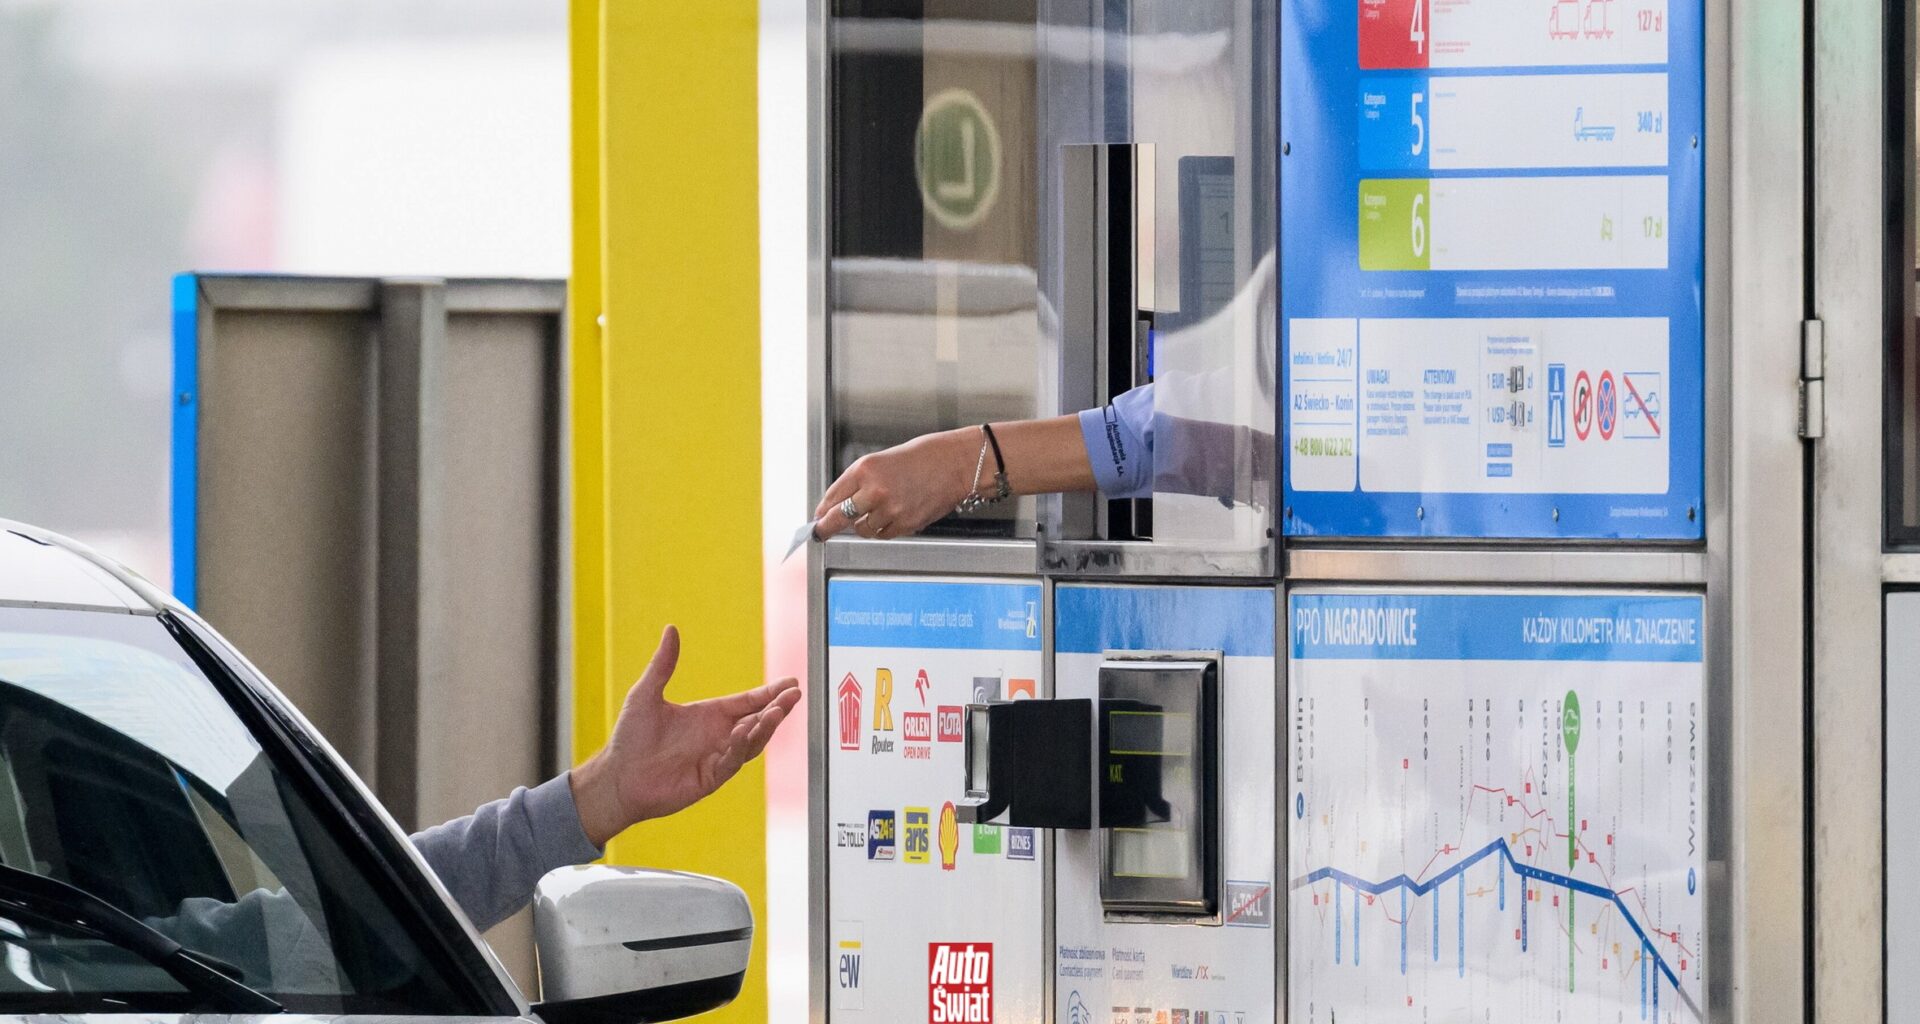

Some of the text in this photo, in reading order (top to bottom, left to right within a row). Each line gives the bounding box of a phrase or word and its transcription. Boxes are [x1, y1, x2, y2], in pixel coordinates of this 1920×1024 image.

[1410, 0, 1425, 54] 4
[1638, 10, 1653, 32] 127
[1411, 93, 1424, 156] 5
[1638, 111, 1653, 133] 340
[1411, 194, 1425, 257] 6
[1643, 216, 1653, 238] 17
[1337, 348, 1352, 368] 24/7
[1367, 369, 1390, 385] UWAGA!
[1423, 369, 1457, 385] ATTENTION!
[1492, 373, 1504, 389] EUR
[1294, 393, 1302, 411] A2
[1304, 389, 1329, 411] Świecko
[1336, 393, 1354, 411] Konin
[1492, 406, 1505, 423] USD
[1294, 437, 1353, 456] +48 800 022 242
[1297, 608, 1417, 646] PPO NAGRADOWICE
[1523, 611, 1696, 645] KAŻDY KILOMETR MA ZNACZENIE
[904, 715, 930, 738] ORLEN
[939, 711, 962, 737] FLOTA
[872, 735, 894, 755] Routex
[1296, 697, 1304, 783] Berlin
[904, 746, 931, 760] OPEN DRIVE
[1688, 701, 1697, 856] Warszawa
[905, 827, 929, 853] aris
[1011, 835, 1031, 850] BIZNES
[840, 953, 861, 988] ew
[930, 945, 990, 984] Auto
[932, 985, 990, 1023] Świat
